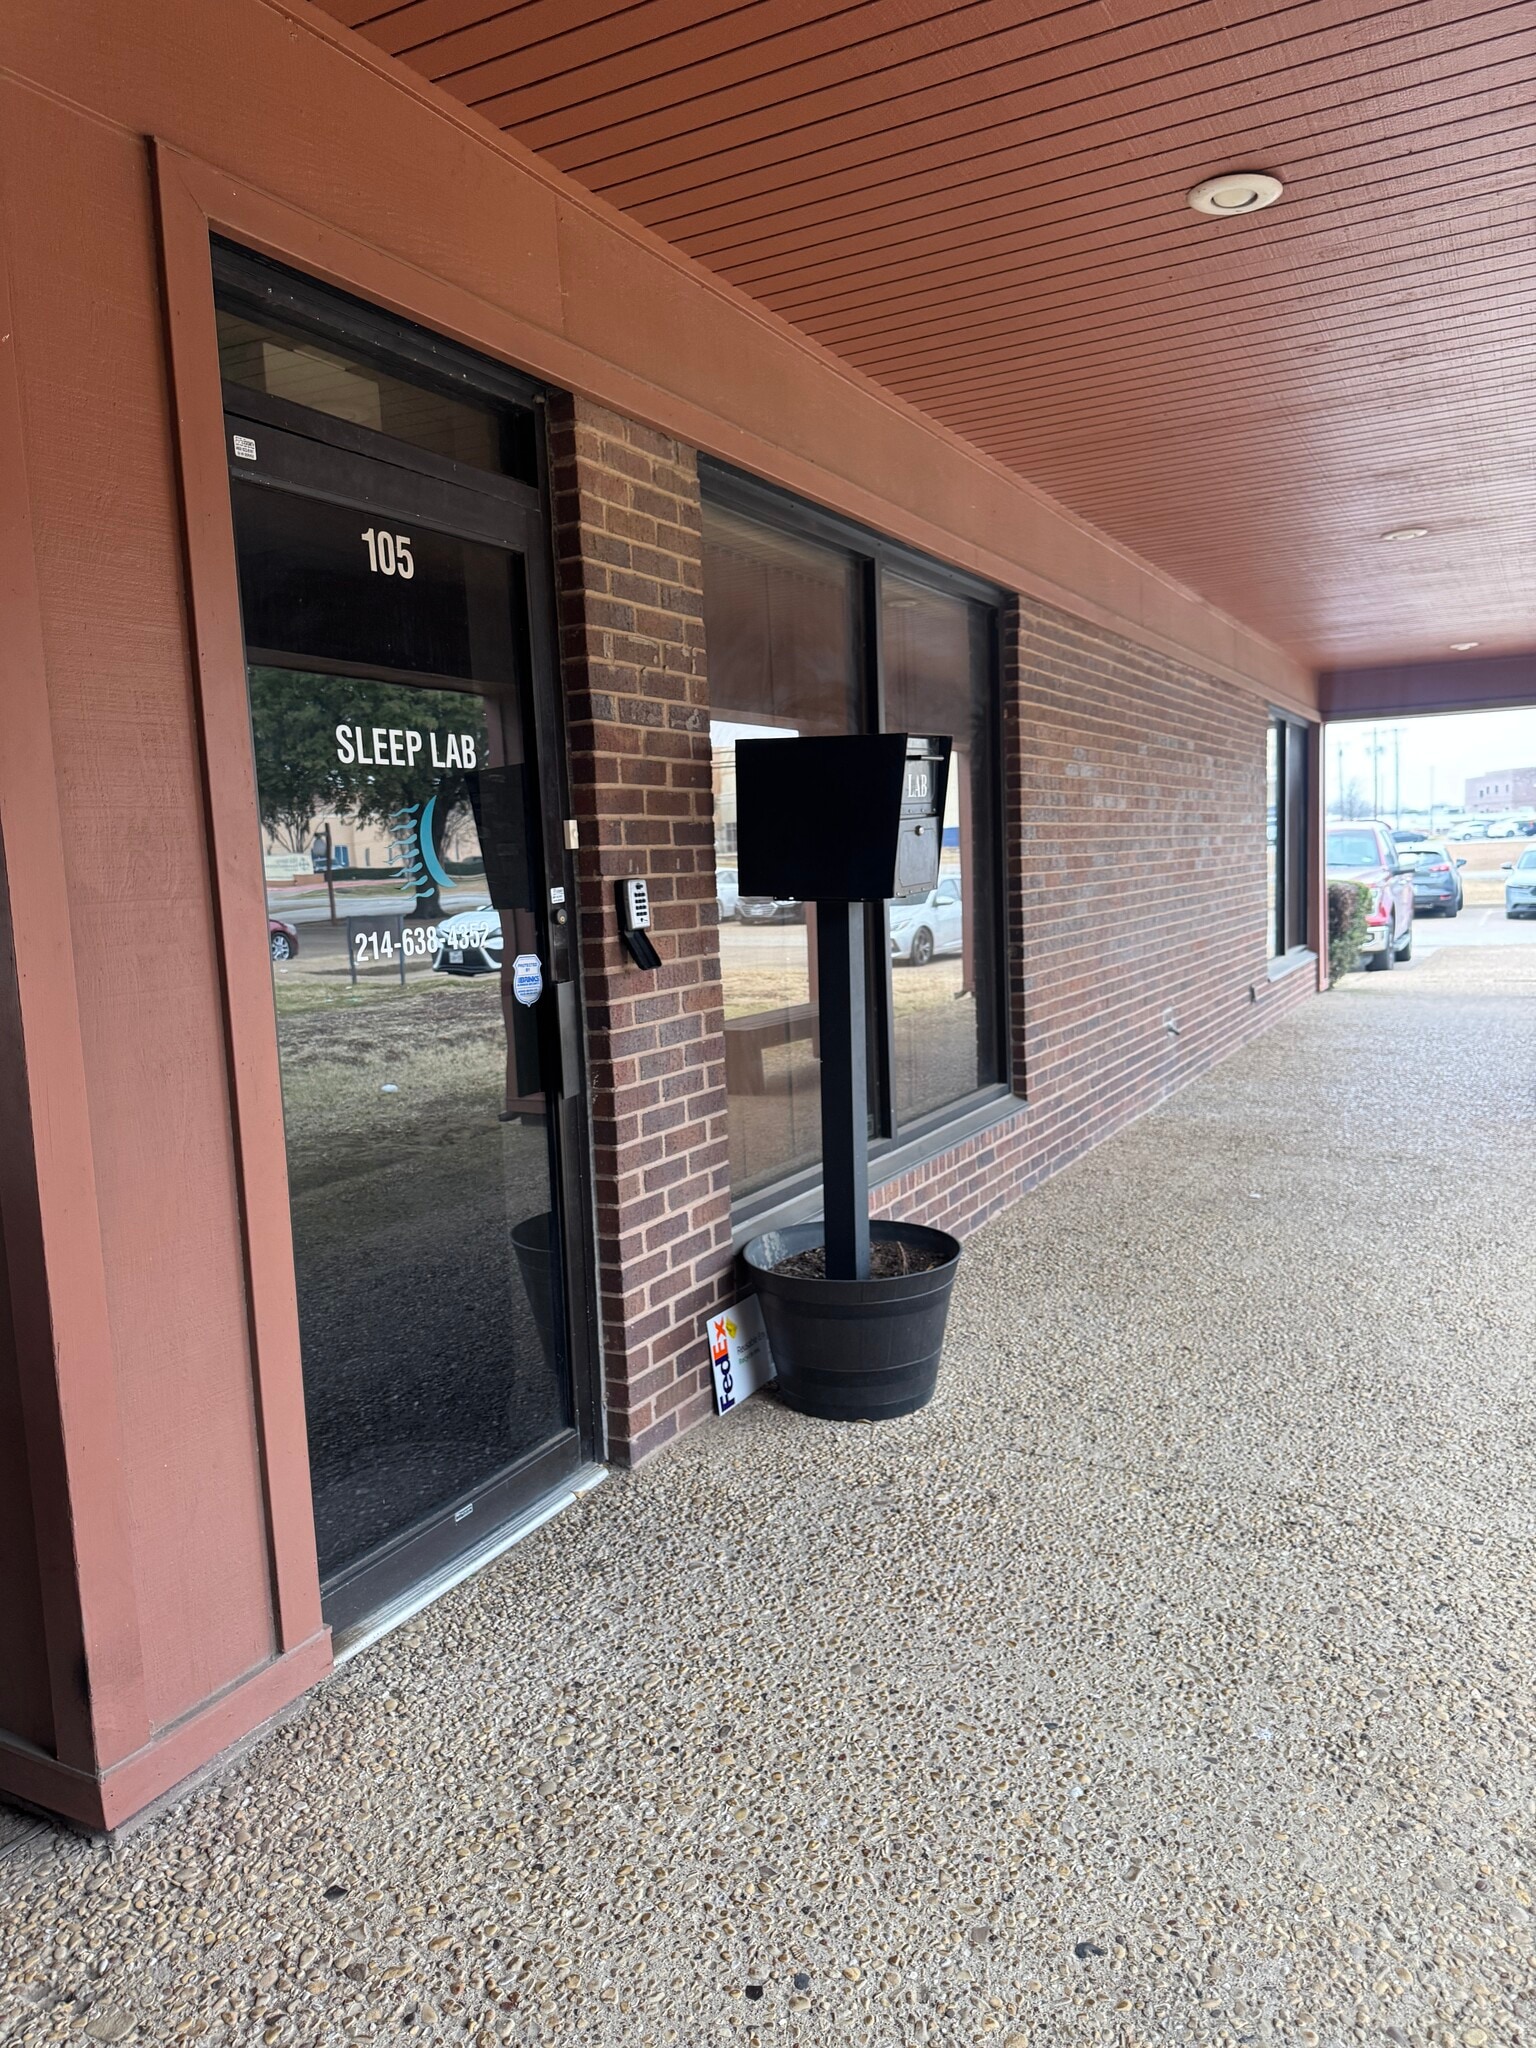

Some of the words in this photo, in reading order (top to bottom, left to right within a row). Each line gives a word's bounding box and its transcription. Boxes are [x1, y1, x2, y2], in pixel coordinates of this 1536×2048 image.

[361, 527, 415, 580] 105
[335, 724, 422, 767] SLEEP
[430, 732, 477, 769] LAB
[908, 774, 928, 798] LAB
[355, 922, 489, 962] 214-638-4352
[713, 1317, 735, 1412] FedEx
